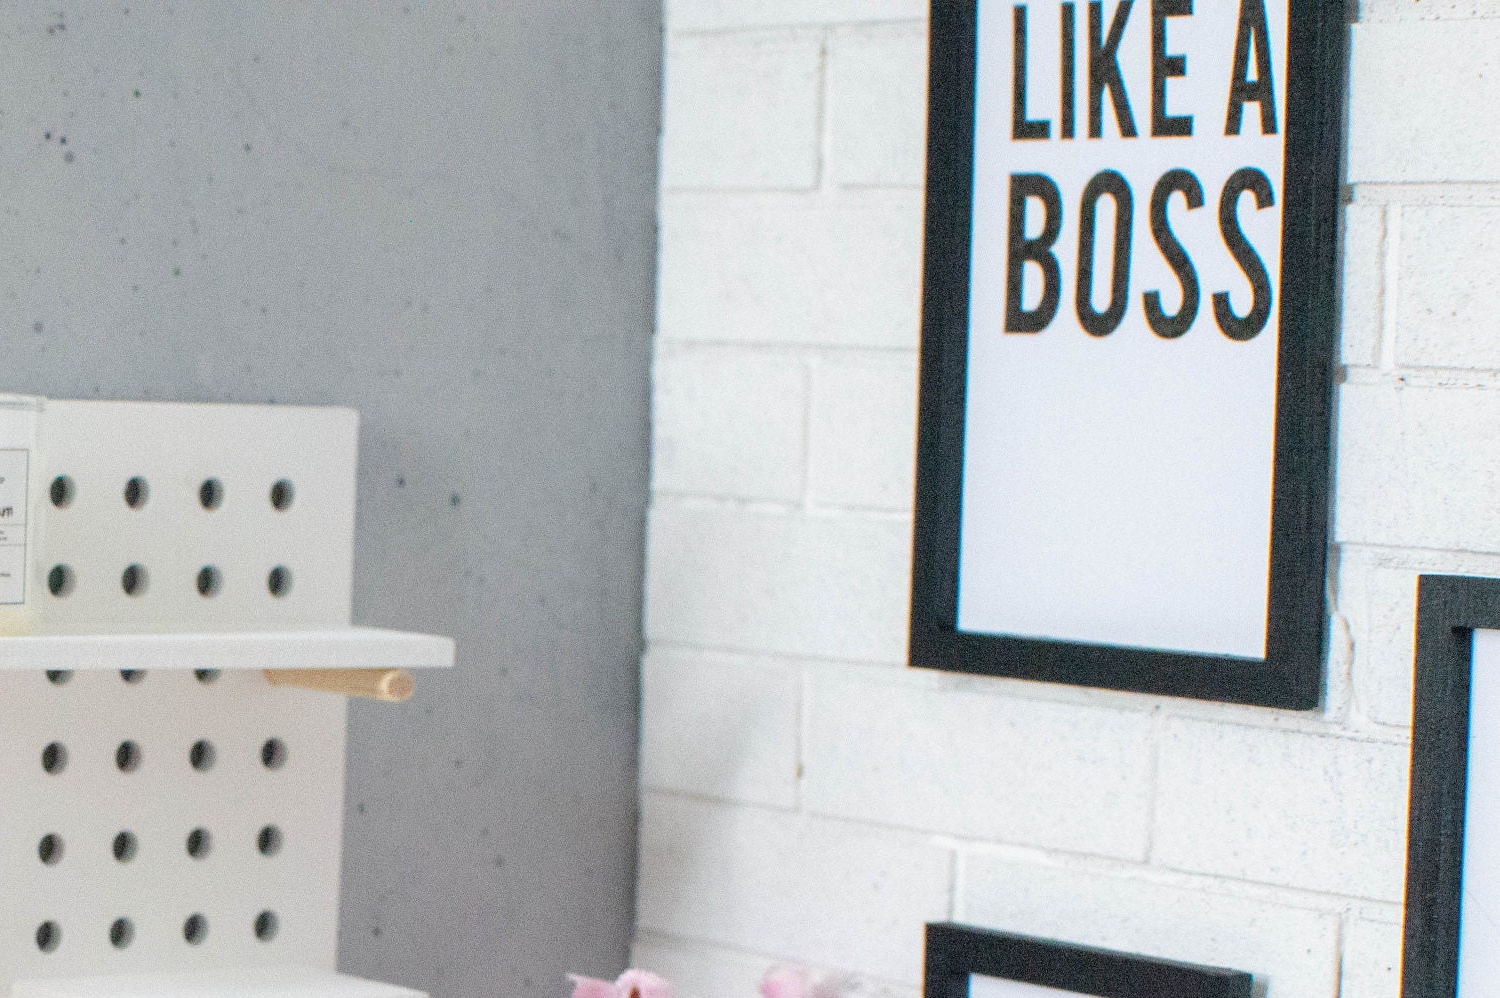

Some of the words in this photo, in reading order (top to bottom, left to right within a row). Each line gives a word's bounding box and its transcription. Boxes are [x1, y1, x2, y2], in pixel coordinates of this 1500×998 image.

[1011, 0, 1194, 140] LIKE
[1224, 0, 1278, 137] A
[1003, 167, 1276, 342] BOSS
